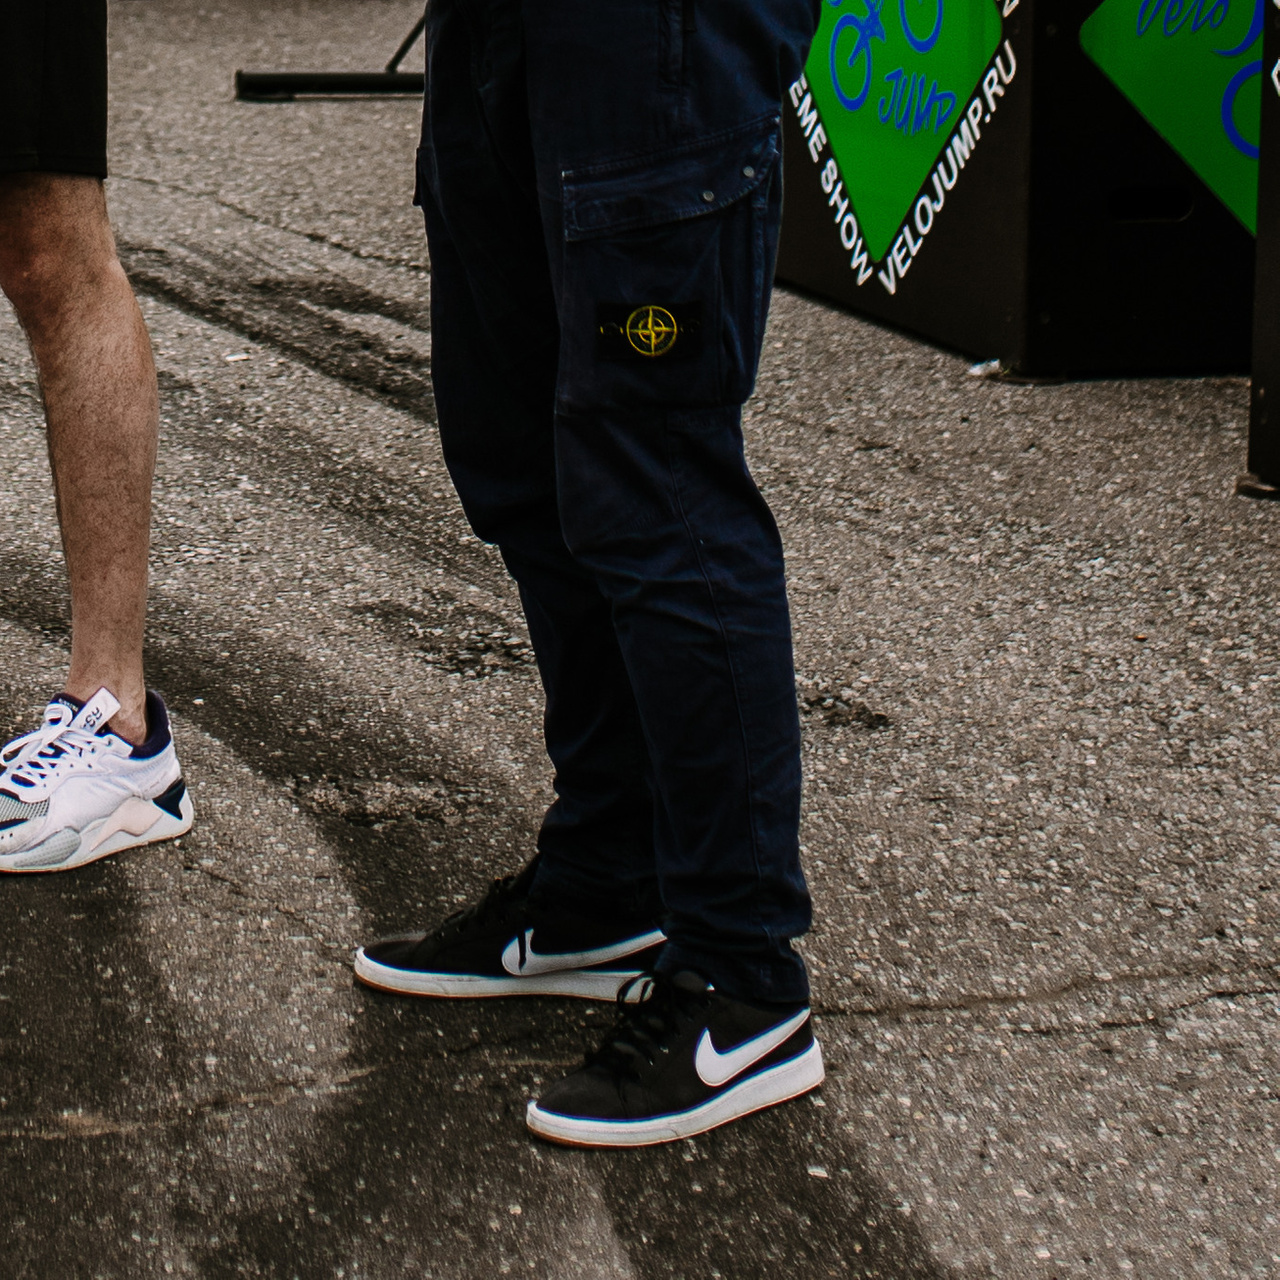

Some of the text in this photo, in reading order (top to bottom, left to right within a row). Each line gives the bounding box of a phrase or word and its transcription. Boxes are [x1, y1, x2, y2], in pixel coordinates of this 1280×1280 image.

[788, 72, 874, 287] EME SHOW
[877, 38, 1017, 295] VELOJUMP.RU
